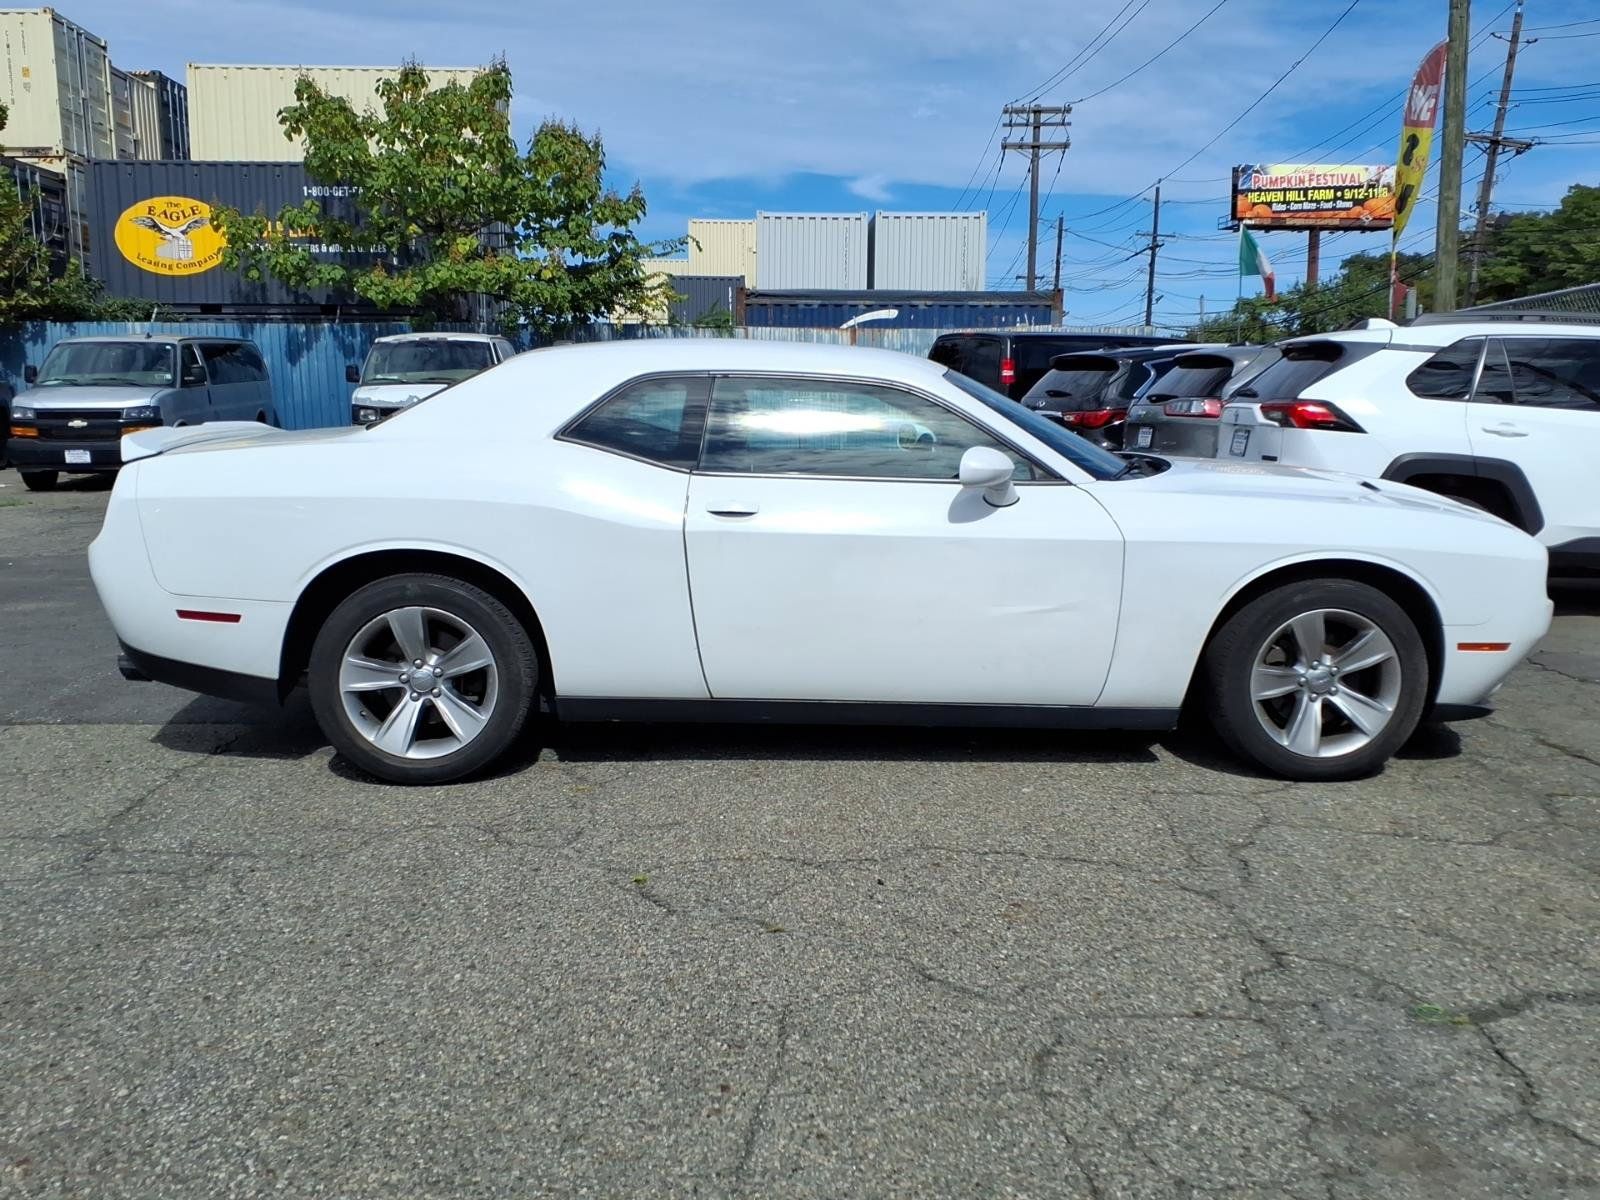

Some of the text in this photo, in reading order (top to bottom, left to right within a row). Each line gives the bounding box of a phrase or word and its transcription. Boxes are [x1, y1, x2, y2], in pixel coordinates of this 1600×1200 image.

[1252, 172, 1362, 188] PUMPKIN FESTIVAL
[1247, 190, 1284, 203] HEAVEN
[1286, 189, 1306, 202] HILL
[1308, 188, 1334, 201] FARM
[164, 201, 182, 209] The
[147, 205, 202, 222] EAGLE
[136, 251, 221, 271] Leasing Company
